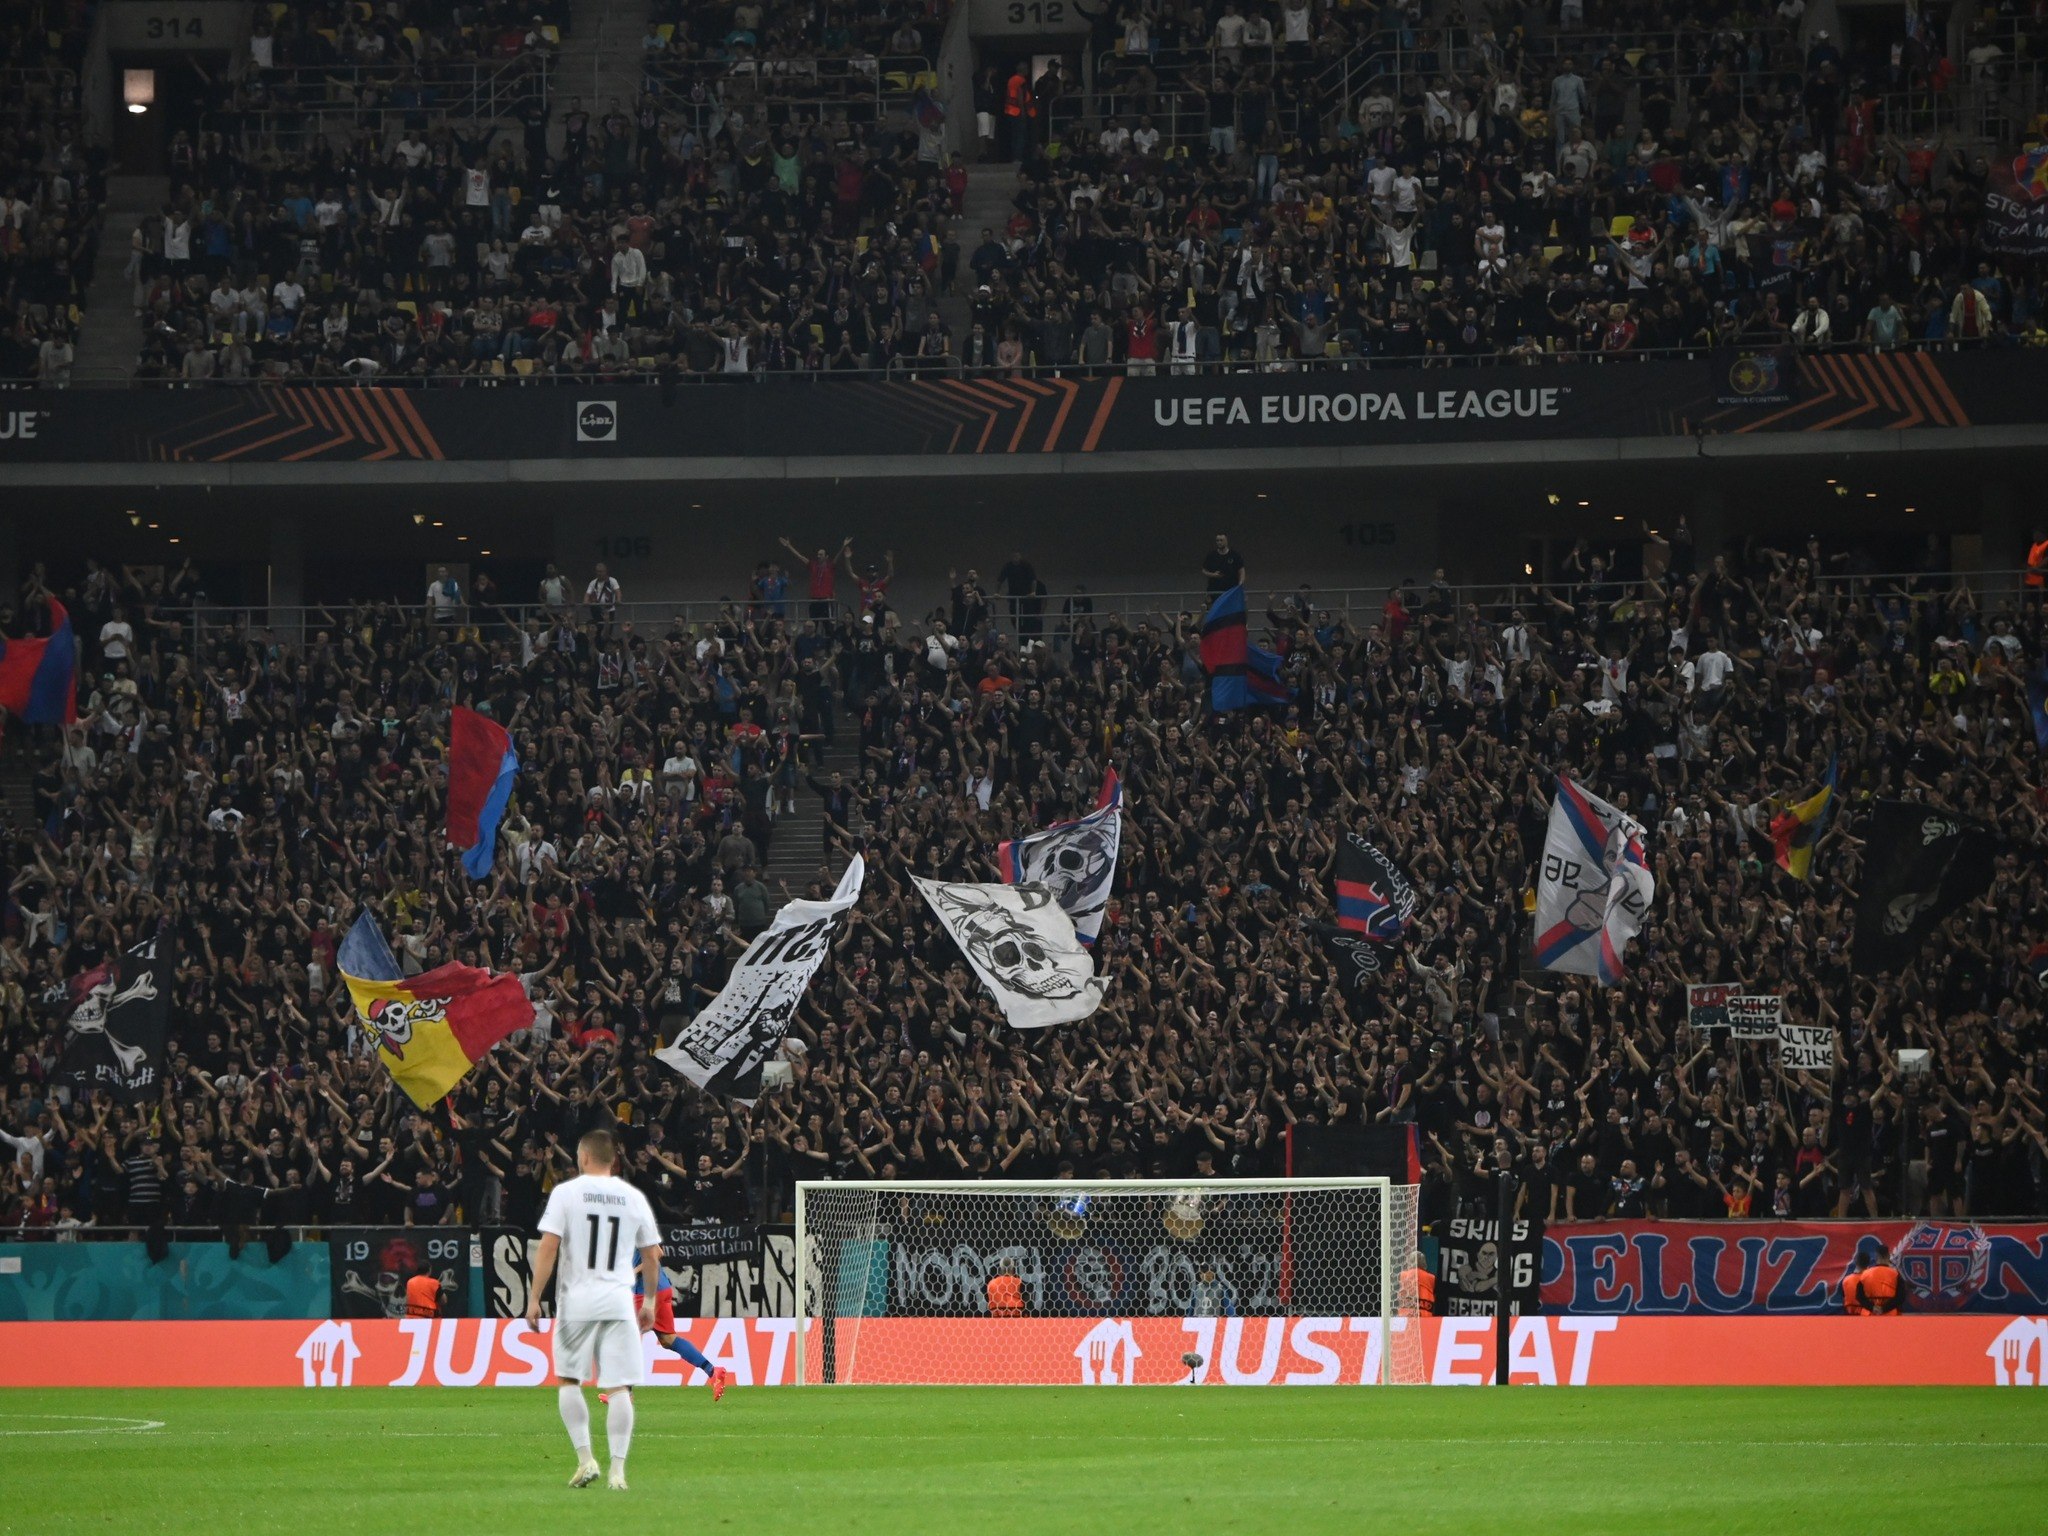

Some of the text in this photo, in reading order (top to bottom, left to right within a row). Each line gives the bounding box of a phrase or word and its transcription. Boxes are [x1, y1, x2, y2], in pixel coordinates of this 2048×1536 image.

[1008, 3, 1064, 24] 312
[147, 18, 203, 38] 314
[580, 413, 613, 426] LIDL
[1154, 397, 1250, 427] UEFA
[1260, 392, 1406, 424] EUROPA
[345, 1240, 459, 1262] 19 96
[587, 1213, 620, 1272] 11
[1440, 1247, 1532, 1288] 196
[1176, 1317, 1618, 1386] JUST EAT
